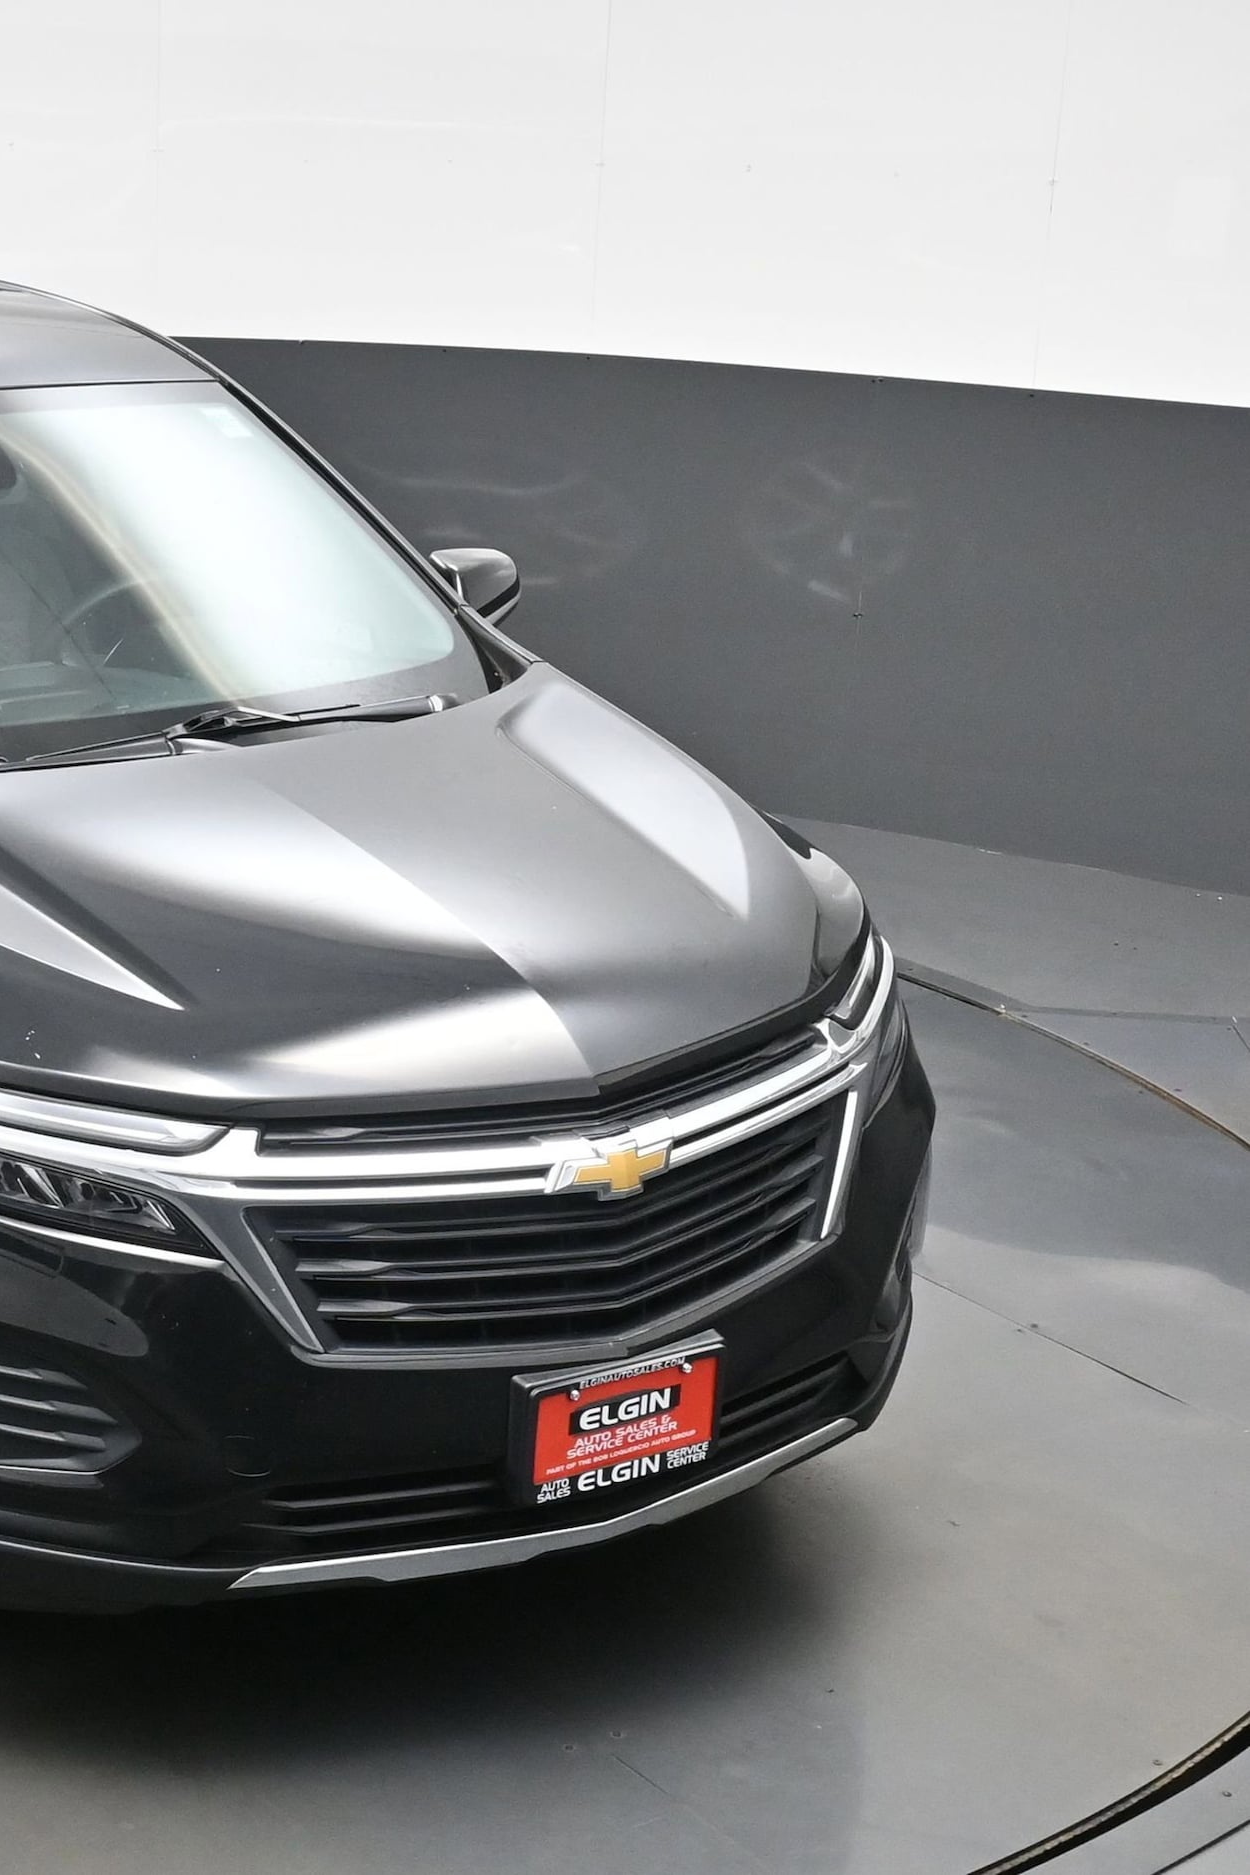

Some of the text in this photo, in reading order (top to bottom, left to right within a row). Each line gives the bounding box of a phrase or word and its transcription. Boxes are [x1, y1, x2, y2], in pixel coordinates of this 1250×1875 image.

[579, 1356, 686, 1390] ELGINAUTOSALES.COM
[579, 1388, 672, 1431] ELGIN
[566, 1421, 678, 1460] SERVICE CENTER
[574, 1414, 672, 1449] AUTO SALES &
[545, 1466, 565, 1476] PART
[578, 1457, 592, 1467] THE
[651, 1437, 671, 1448] AUTO
[671, 1429, 697, 1442] GROUP
[666, 1441, 710, 1461] SERVICE
[667, 1452, 707, 1470] CENTER
[540, 1478, 570, 1493] AUTO
[577, 1454, 661, 1492] ELGIN
[536, 1488, 572, 1505] SALES
